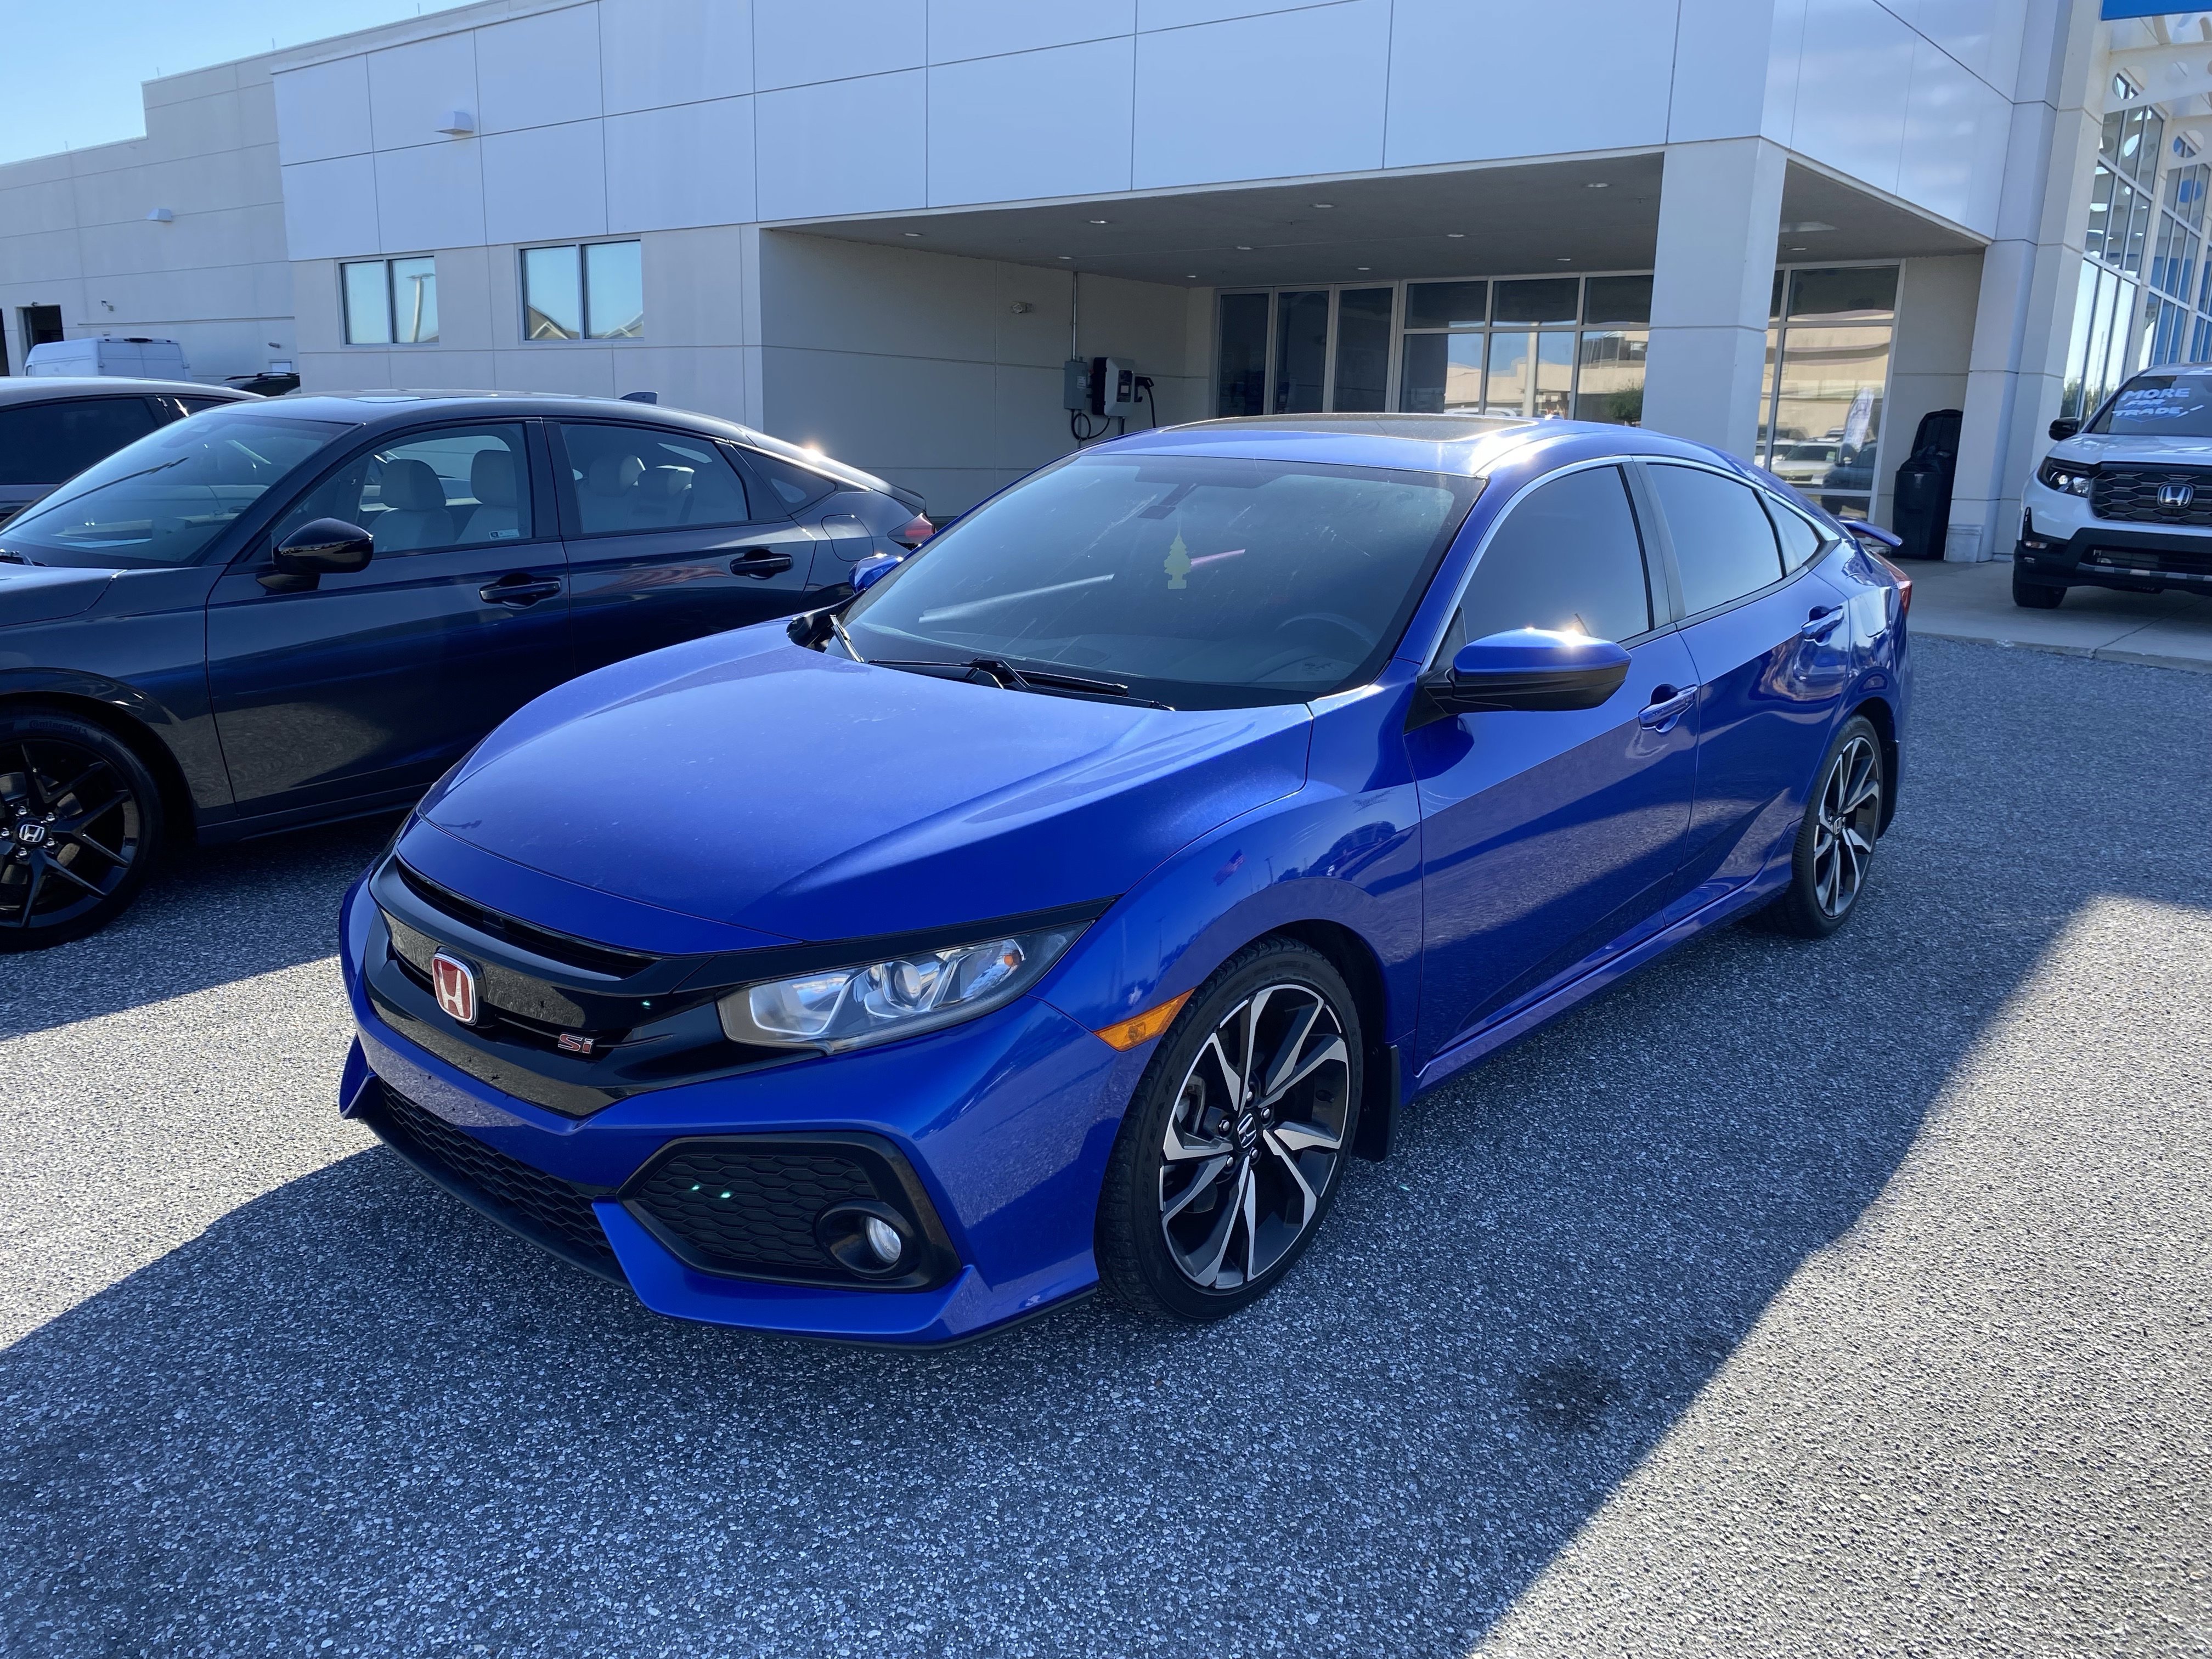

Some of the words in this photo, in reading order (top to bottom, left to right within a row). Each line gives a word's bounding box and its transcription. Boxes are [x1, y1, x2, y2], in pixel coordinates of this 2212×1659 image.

[2121, 387, 2191, 401] MORE
[2112, 407, 2184, 417] TRADE
[557, 1032, 594, 1054] Si
